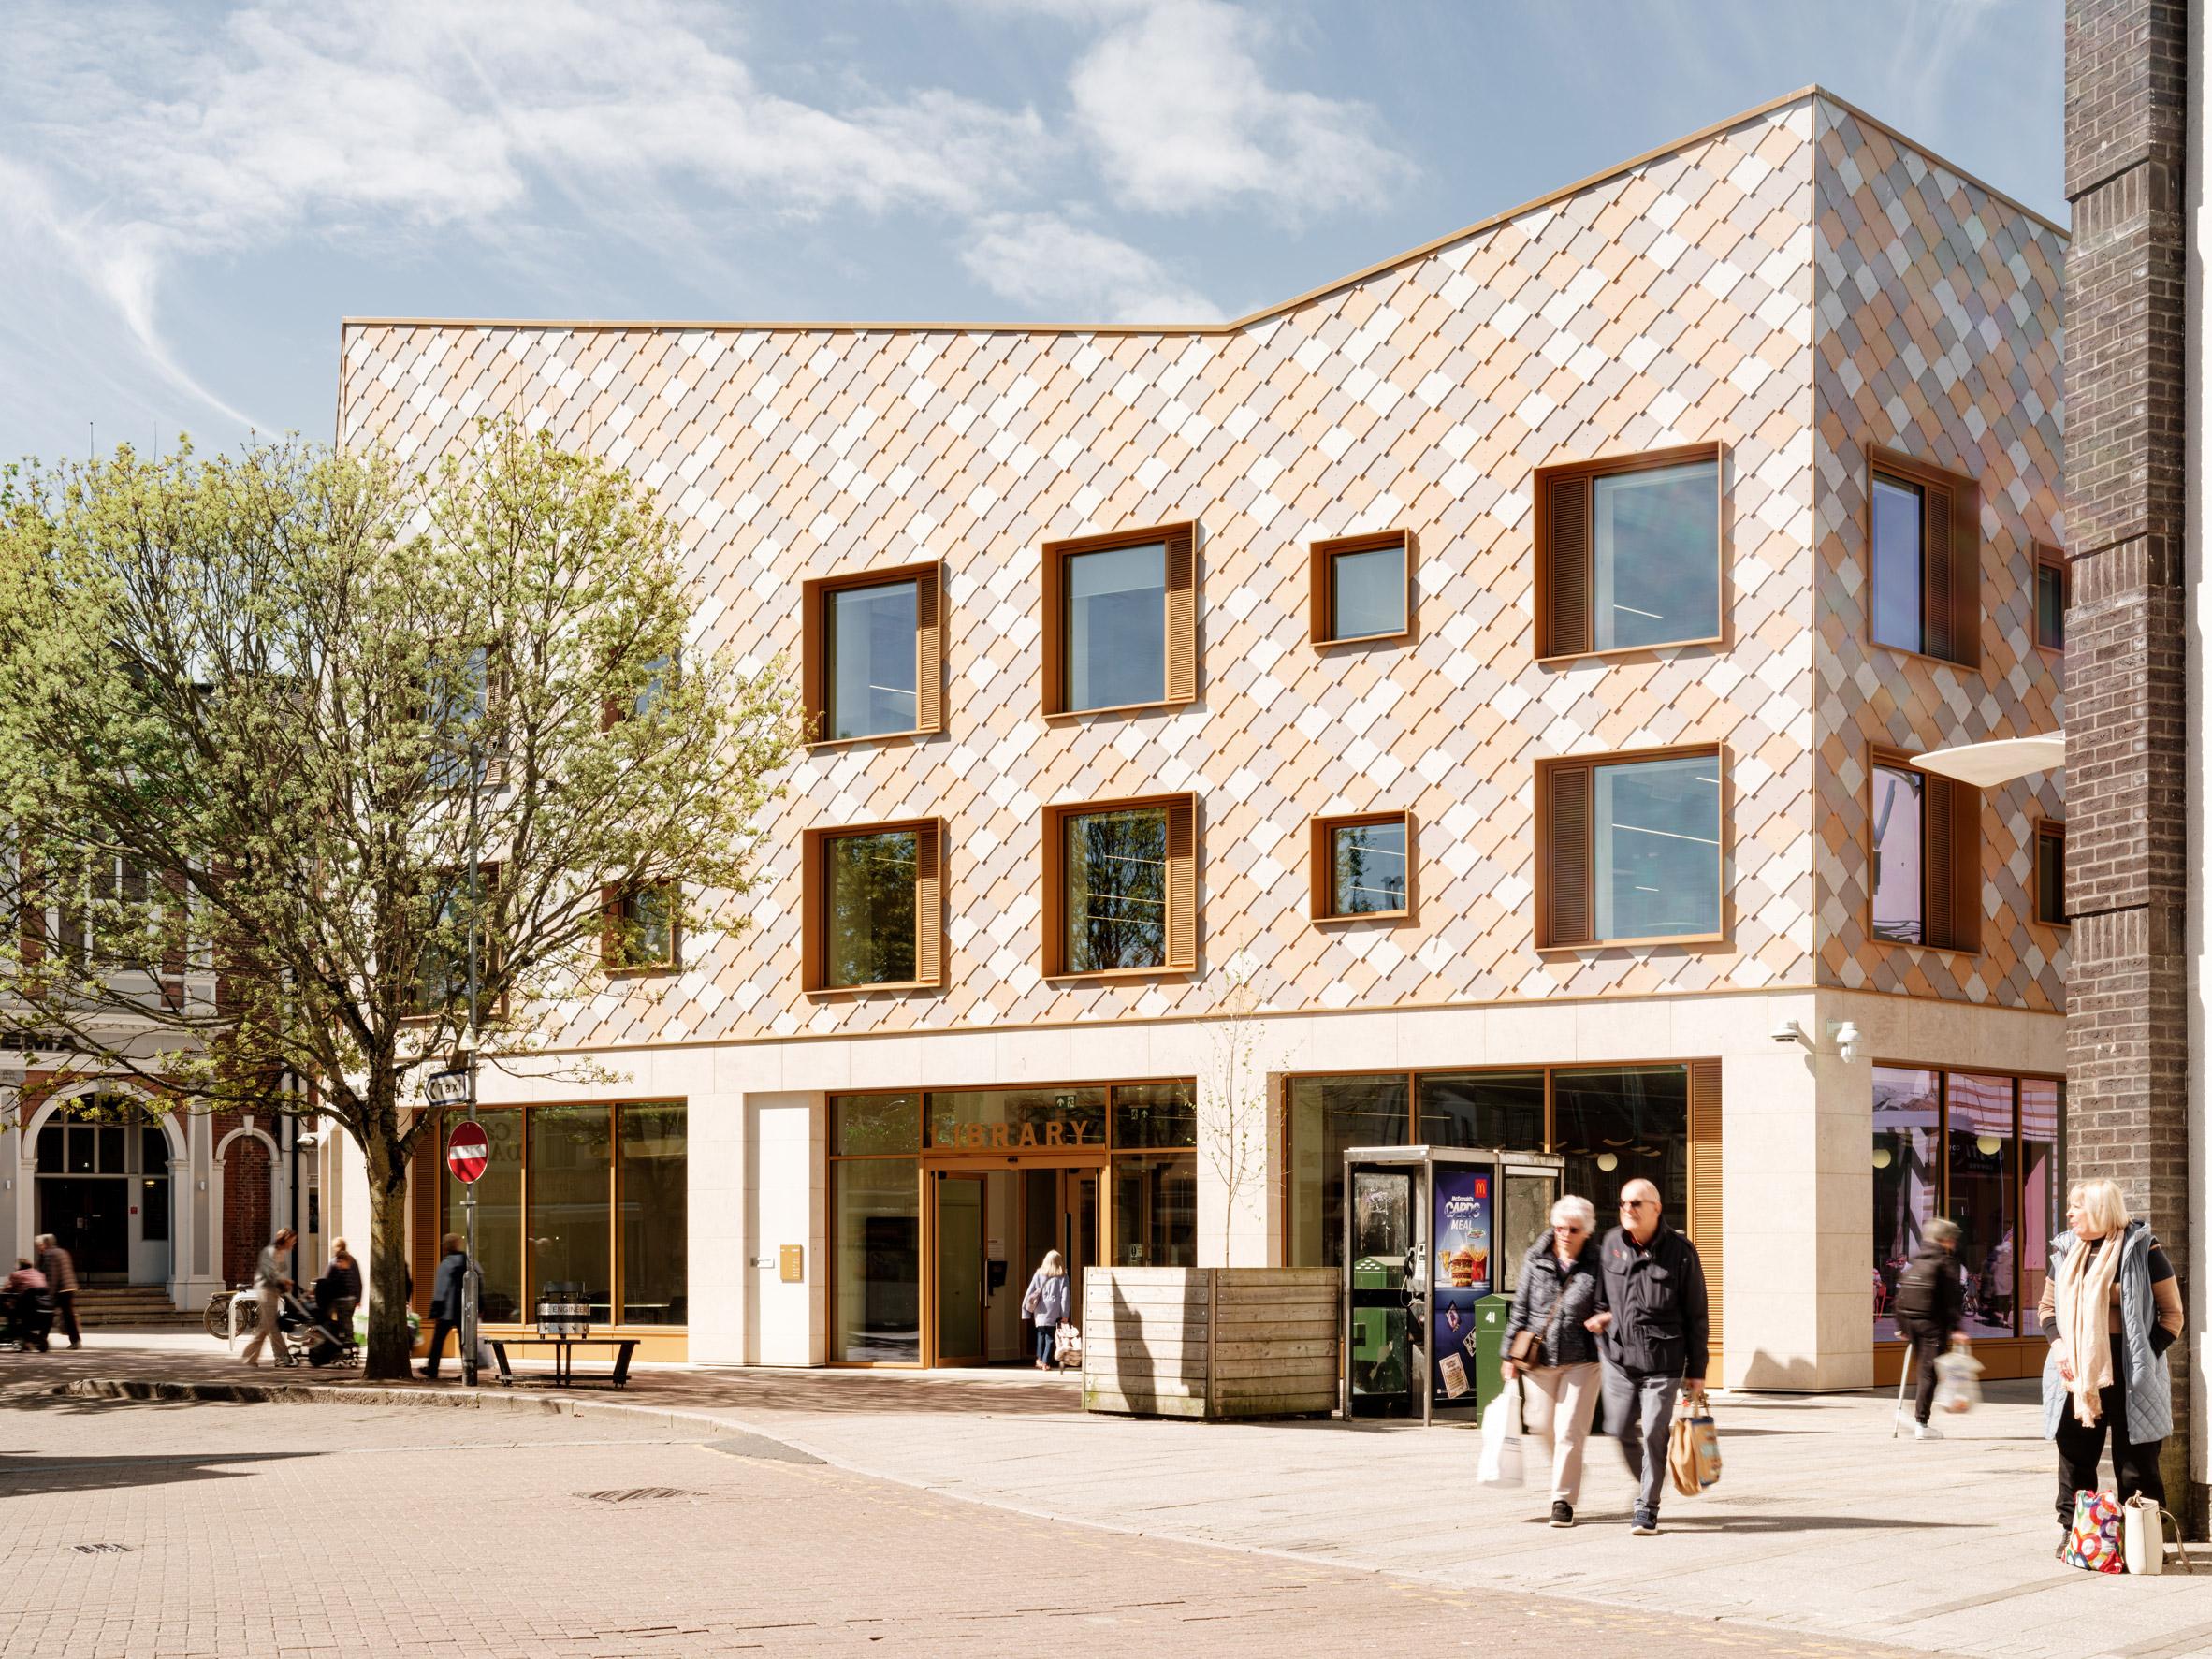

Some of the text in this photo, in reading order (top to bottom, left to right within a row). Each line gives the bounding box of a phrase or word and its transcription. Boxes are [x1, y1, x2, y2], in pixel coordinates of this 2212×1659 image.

[438, 1079, 461, 1095] Taxi
[931, 1121, 1088, 1148] LIBRARY
[1450, 1219, 1473, 1230] MEAL
[1485, 1311, 1496, 1324] 41
